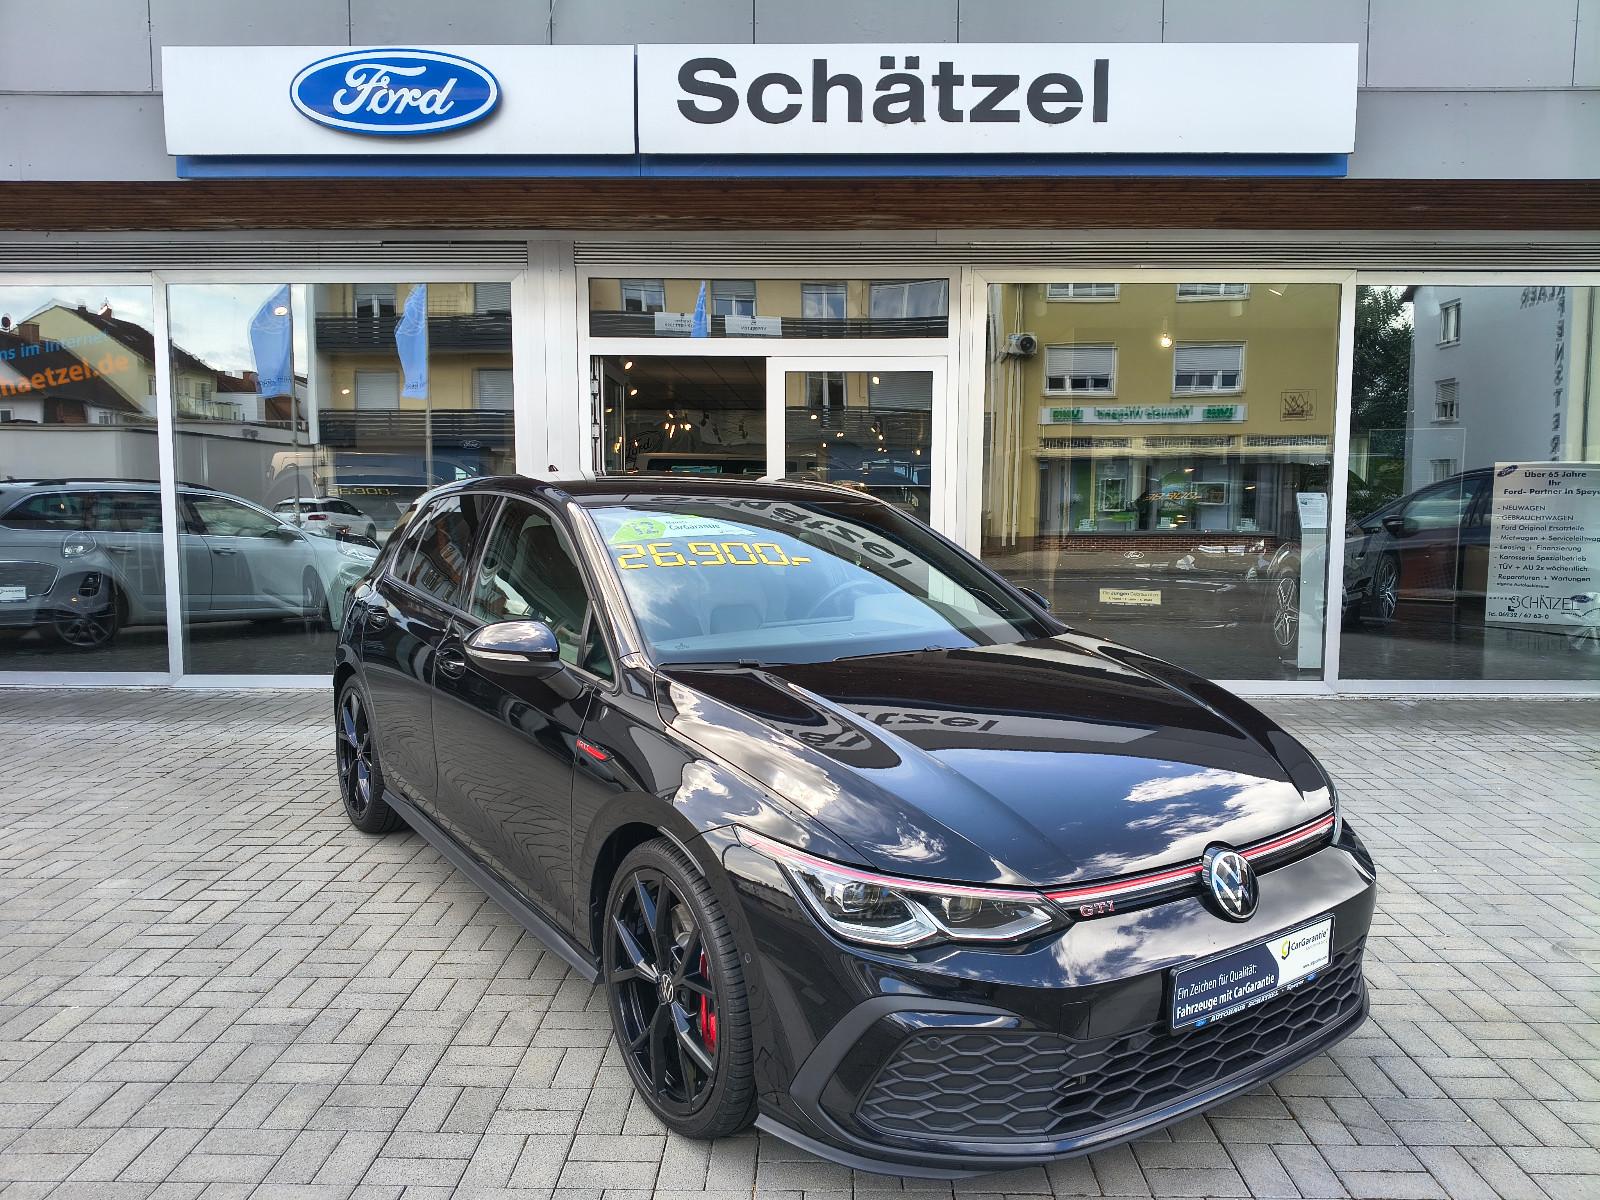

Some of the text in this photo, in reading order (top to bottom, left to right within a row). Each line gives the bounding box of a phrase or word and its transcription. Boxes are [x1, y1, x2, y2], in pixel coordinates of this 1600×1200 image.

[333, 63, 457, 116] Ford
[677, 55, 1109, 125] Schätzel
[20, 342, 40, 359] im
[1524, 470, 1546, 478] Über
[1519, 524, 1547, 532] Original
[1536, 545, 1582, 553] Finanzierung
[1498, 573, 1540, 581] Reparaturen
[1509, 594, 1581, 611] SCHÄTZEL
[1079, 899, 1115, 917] GTI
[1290, 930, 1327, 951] CarGarantie
[1177, 963, 1257, 1001] Ein Zeichen für Qualität:
[1176, 973, 1275, 1020] Fahrzeuge mit CarGarantie
